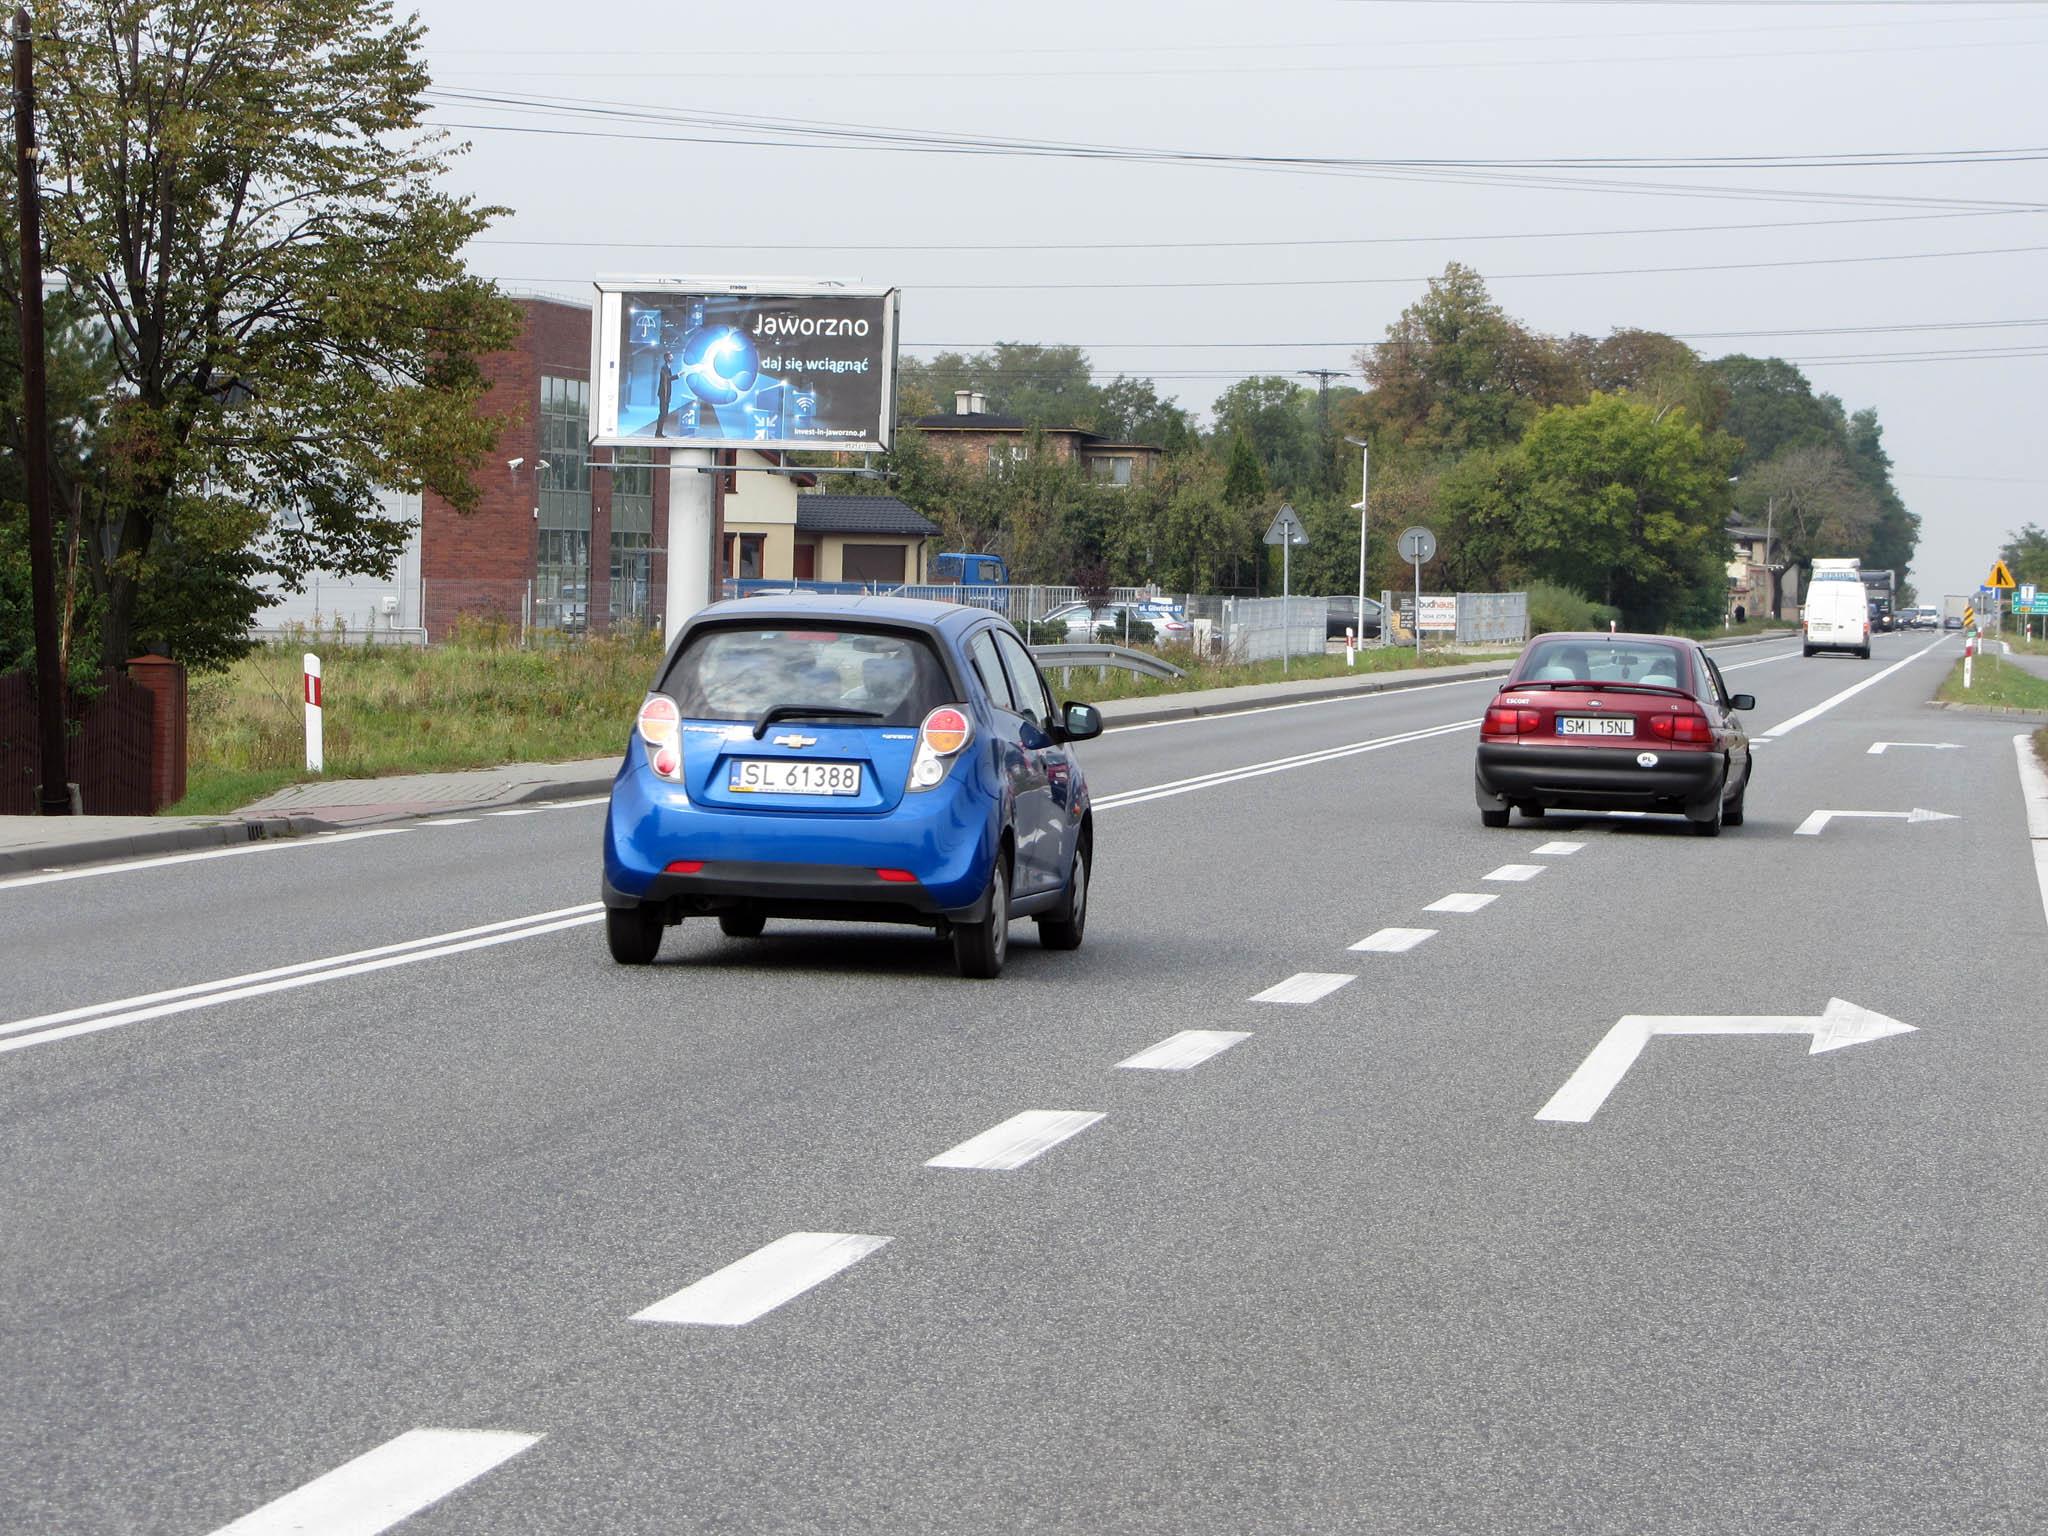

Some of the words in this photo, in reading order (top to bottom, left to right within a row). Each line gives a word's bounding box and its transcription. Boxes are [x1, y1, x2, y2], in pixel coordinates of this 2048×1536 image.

[752, 313, 869, 337] Jaworzno
[762, 357, 781, 372] daj
[785, 357, 803, 373] się
[806, 357, 868, 374] wciągnąć
[1566, 719, 1591, 733] SMI
[1600, 720, 1631, 734] 15NL
[745, 764, 775, 786] SL
[786, 765, 854, 788] 61388
